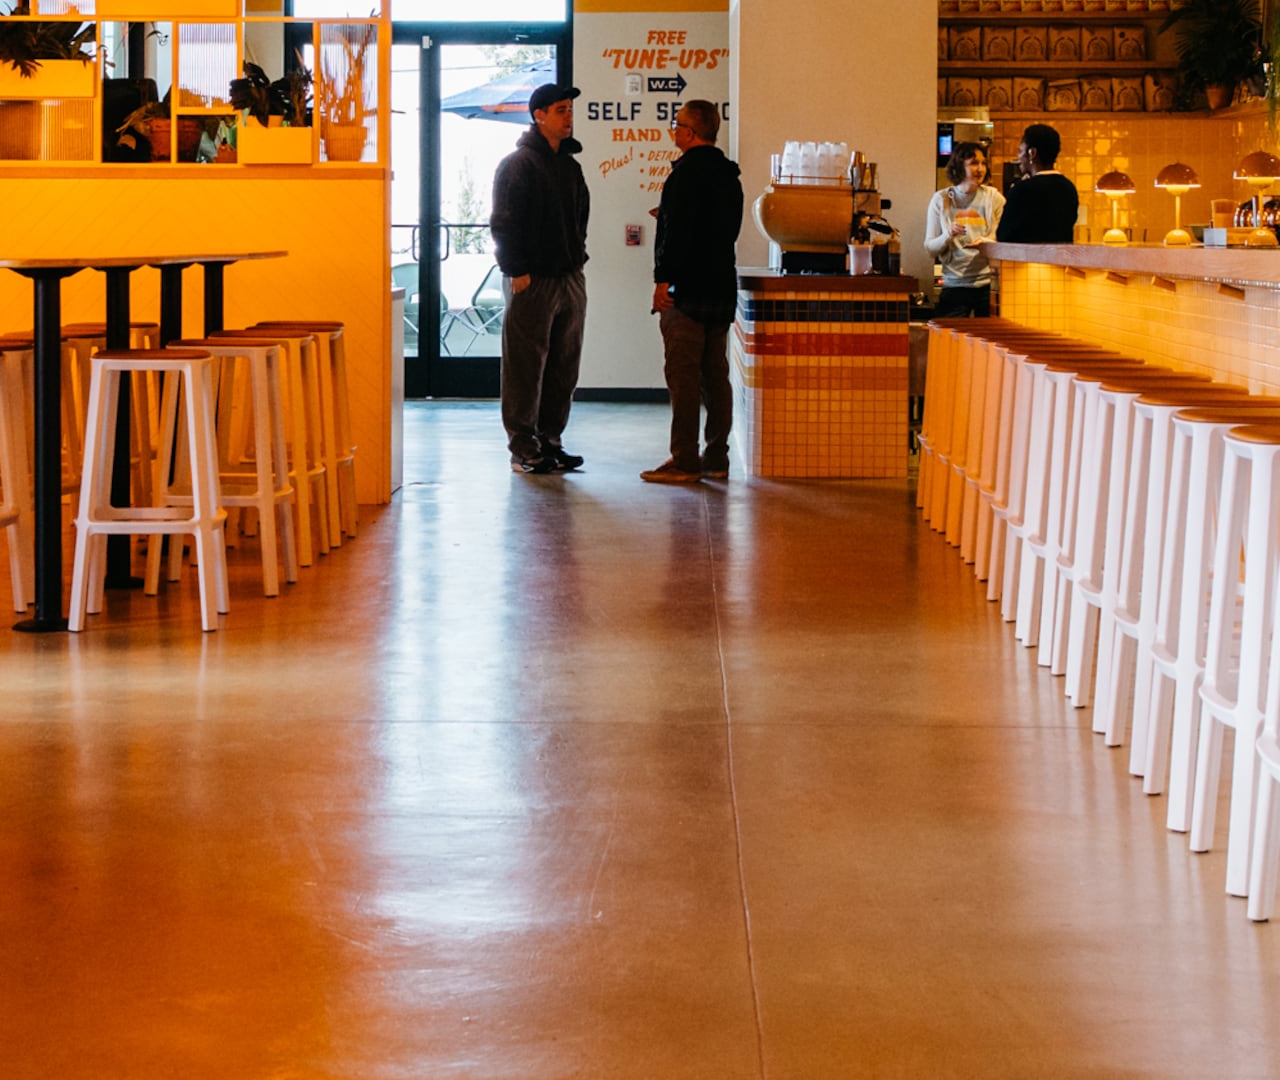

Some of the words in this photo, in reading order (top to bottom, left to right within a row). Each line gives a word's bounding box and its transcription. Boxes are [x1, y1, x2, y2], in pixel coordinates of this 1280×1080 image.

[647, 30, 687, 45] FREE
[650, 80, 682, 89] W.C.
[588, 102, 642, 120] SELF
[612, 128, 662, 142] HAND
[649, 166, 672, 177] WAX
